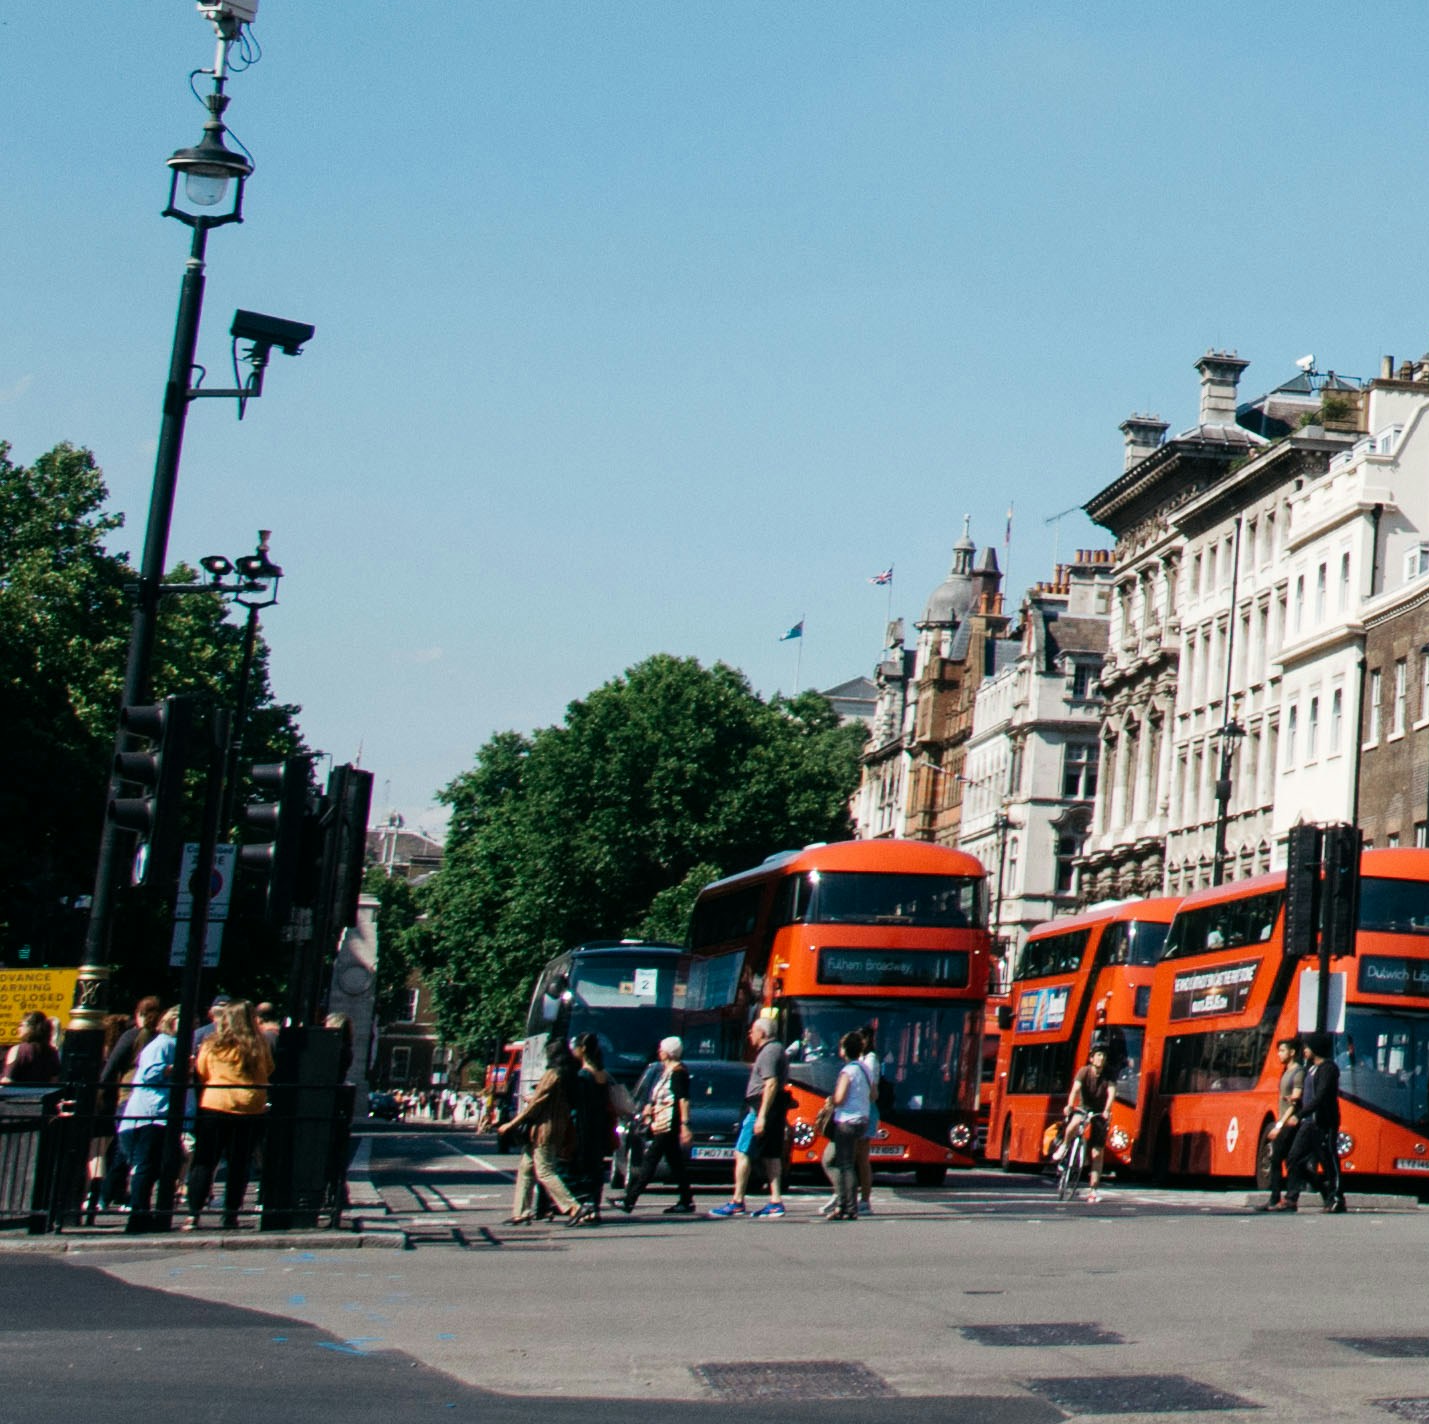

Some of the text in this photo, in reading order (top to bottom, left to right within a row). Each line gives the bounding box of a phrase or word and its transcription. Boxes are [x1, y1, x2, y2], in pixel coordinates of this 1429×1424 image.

[827, 957, 912, 975] Fulham Broadway
[935, 959, 949, 979] 11
[0, 973, 51, 982] DVANCE
[1367, 965, 1410, 980] Dulwich
[0, 982, 51, 991] ARNING
[641, 978, 651, 990] 2
[13, 993, 65, 1003] CLOSED
